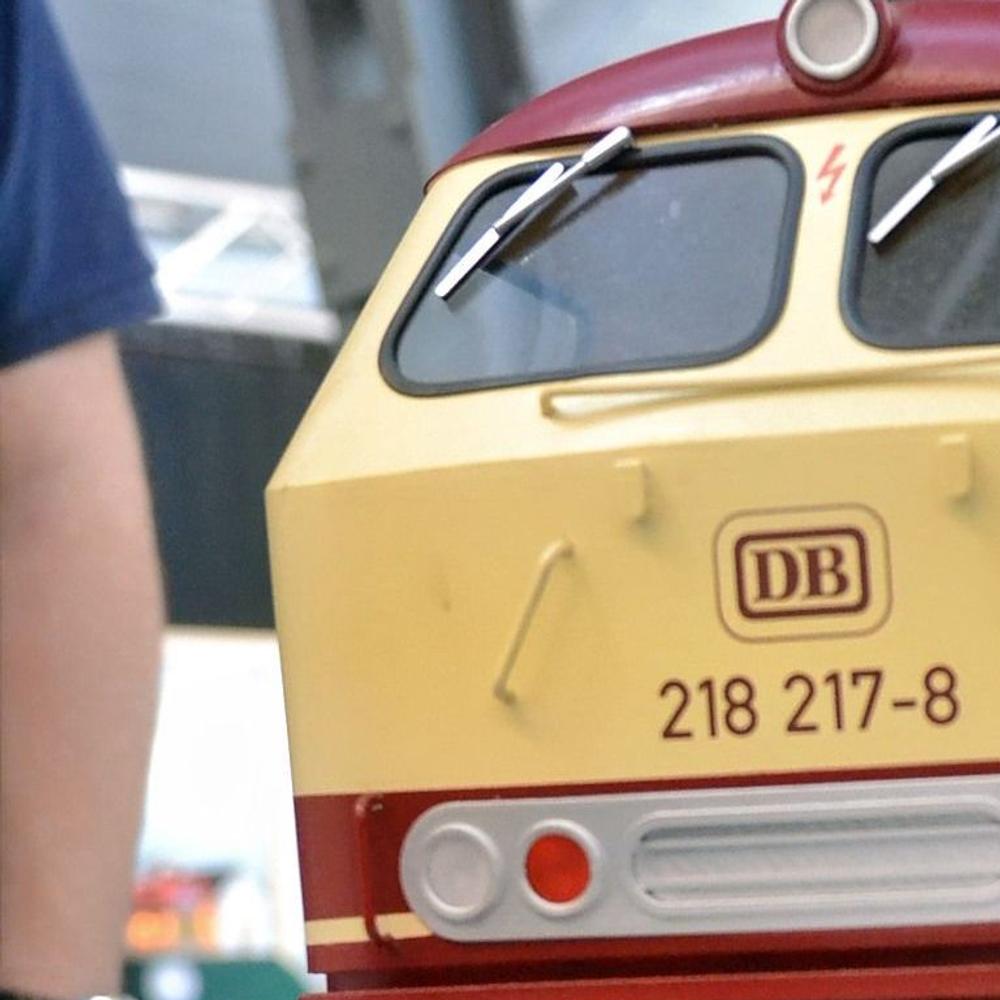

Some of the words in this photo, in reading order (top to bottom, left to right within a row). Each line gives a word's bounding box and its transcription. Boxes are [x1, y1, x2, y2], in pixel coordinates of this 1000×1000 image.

[752, 546, 850, 603] DB
[659, 676, 757, 739] 218
[783, 665, 960, 733] 217-8
